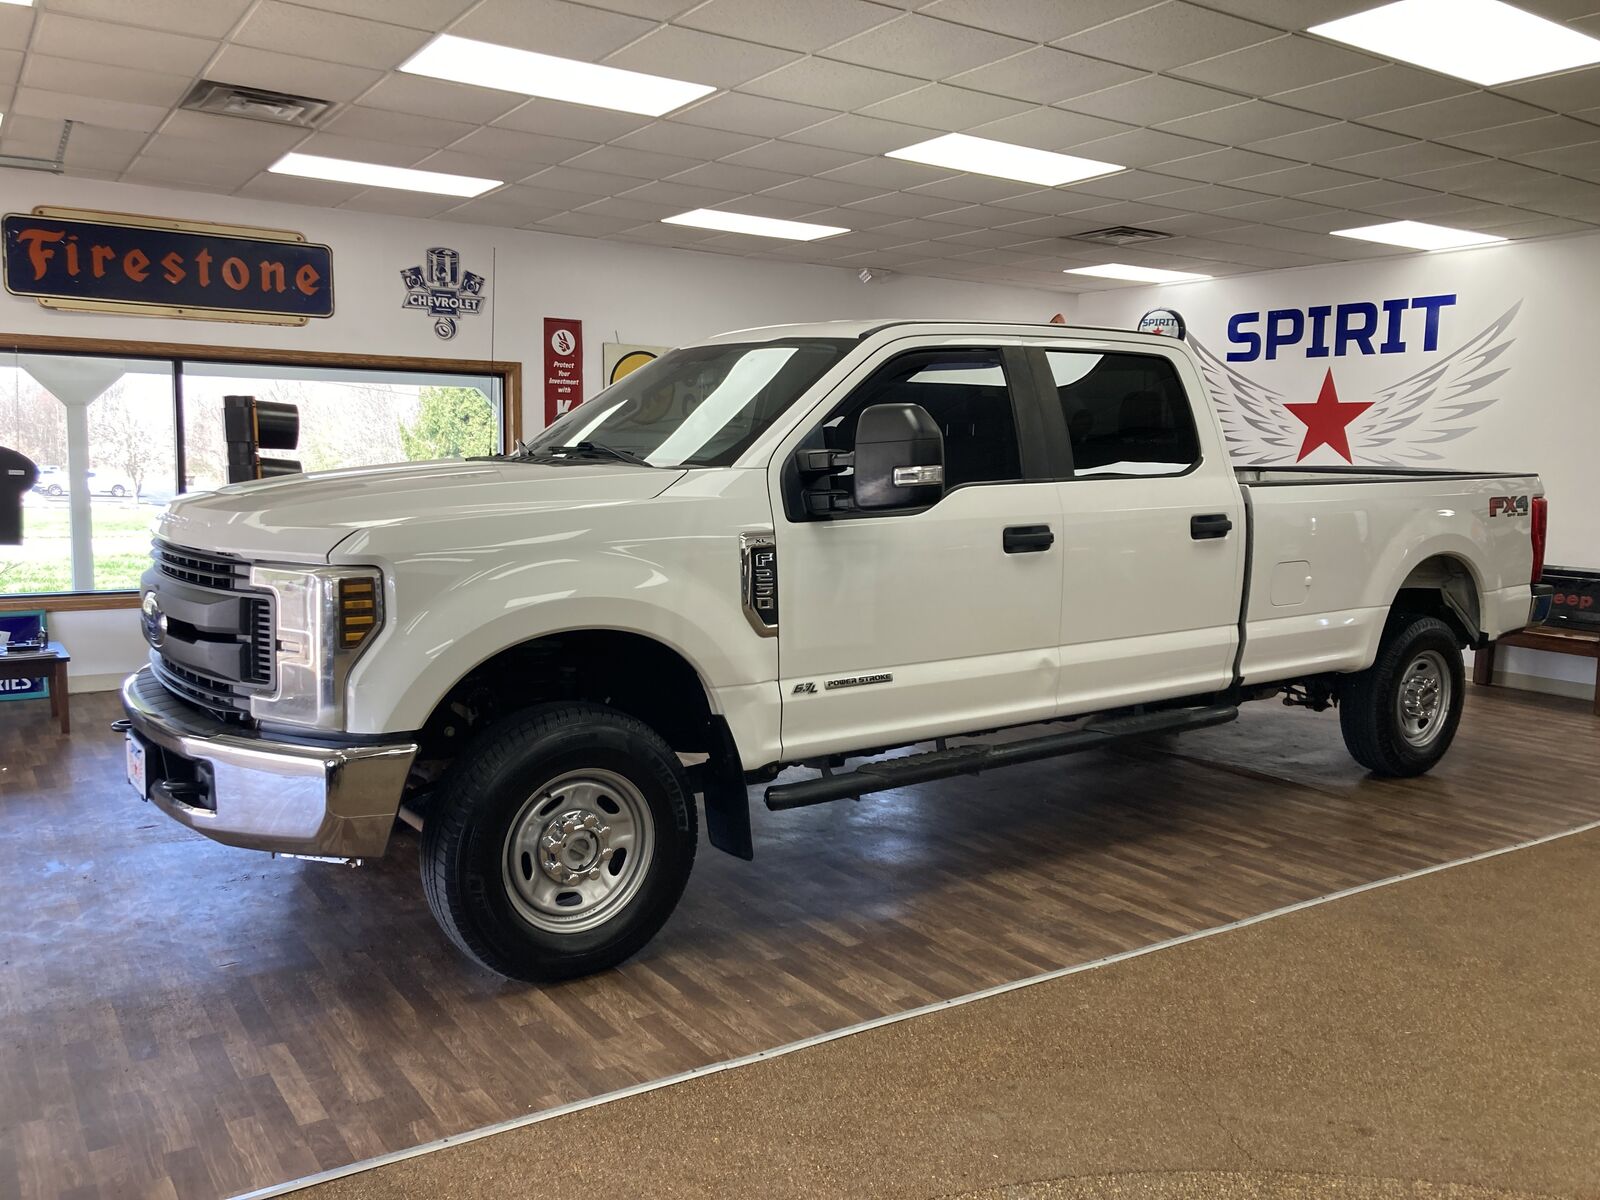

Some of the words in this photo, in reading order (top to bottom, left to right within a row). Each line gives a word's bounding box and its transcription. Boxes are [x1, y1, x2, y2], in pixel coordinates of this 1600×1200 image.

[17, 228, 321, 296] Firestone
[409, 295, 478, 309] CHEVROLET
[1142, 318, 1176, 327] SPIRIT
[1226, 294, 1457, 362] SPIRIT
[553, 361, 575, 369] Protect
[548, 378, 579, 386] Investment
[557, 386, 571, 394] with
[1489, 495, 1529, 517] FX4
[1553, 592, 1593, 609] eep
[827, 678, 857, 687] POWER
[858, 673, 892, 682] STROKE
